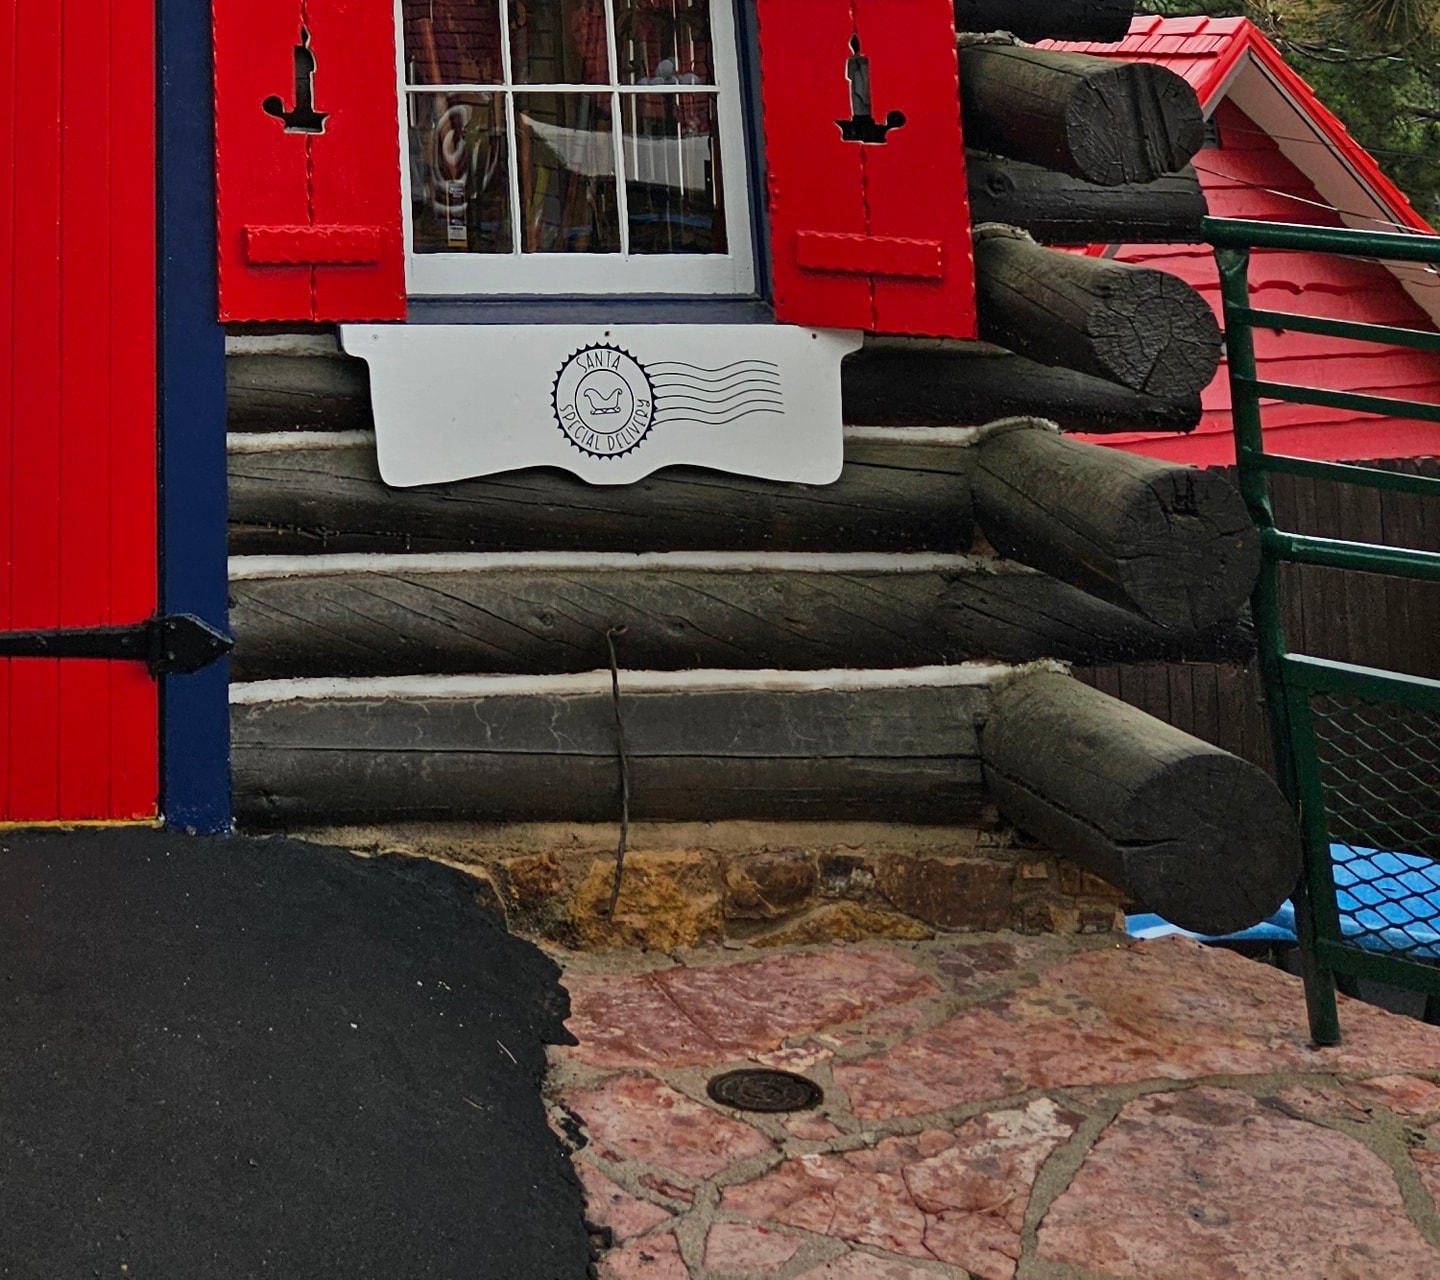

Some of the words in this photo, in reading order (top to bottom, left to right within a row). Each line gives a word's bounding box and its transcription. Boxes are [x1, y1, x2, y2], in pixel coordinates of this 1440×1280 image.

[575, 350, 622, 374] SANTA
[559, 403, 600, 452] SPECIAL
[607, 397, 652, 452] DELIVERY
